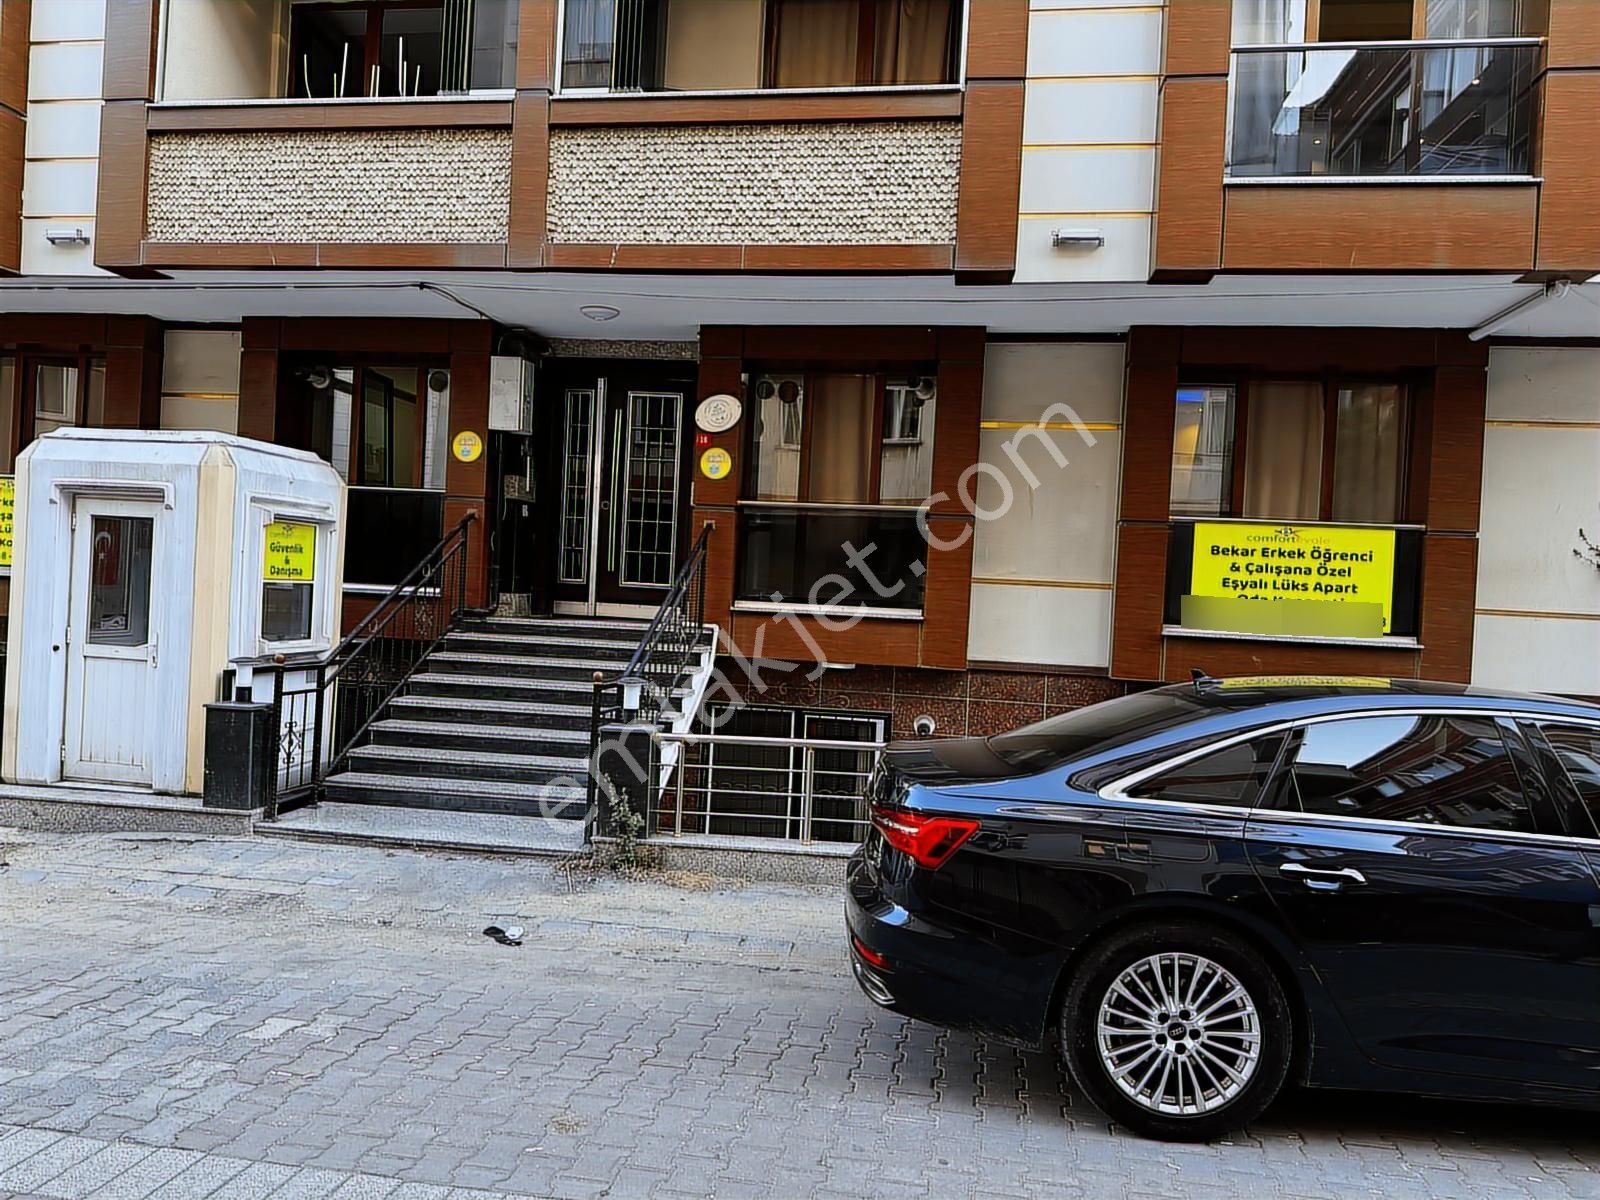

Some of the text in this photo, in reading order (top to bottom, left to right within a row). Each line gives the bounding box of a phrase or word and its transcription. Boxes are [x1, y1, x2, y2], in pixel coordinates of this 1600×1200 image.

[269, 541, 304, 554] Güvenlik
[1210, 545, 1373, 563] Bekar Erkek Öğrenci
[269, 565, 304, 578] Danışma
[1229, 561, 1352, 578] & Çalışana Özel
[1222, 577, 1358, 595] Eşyalı Lüks Apart
